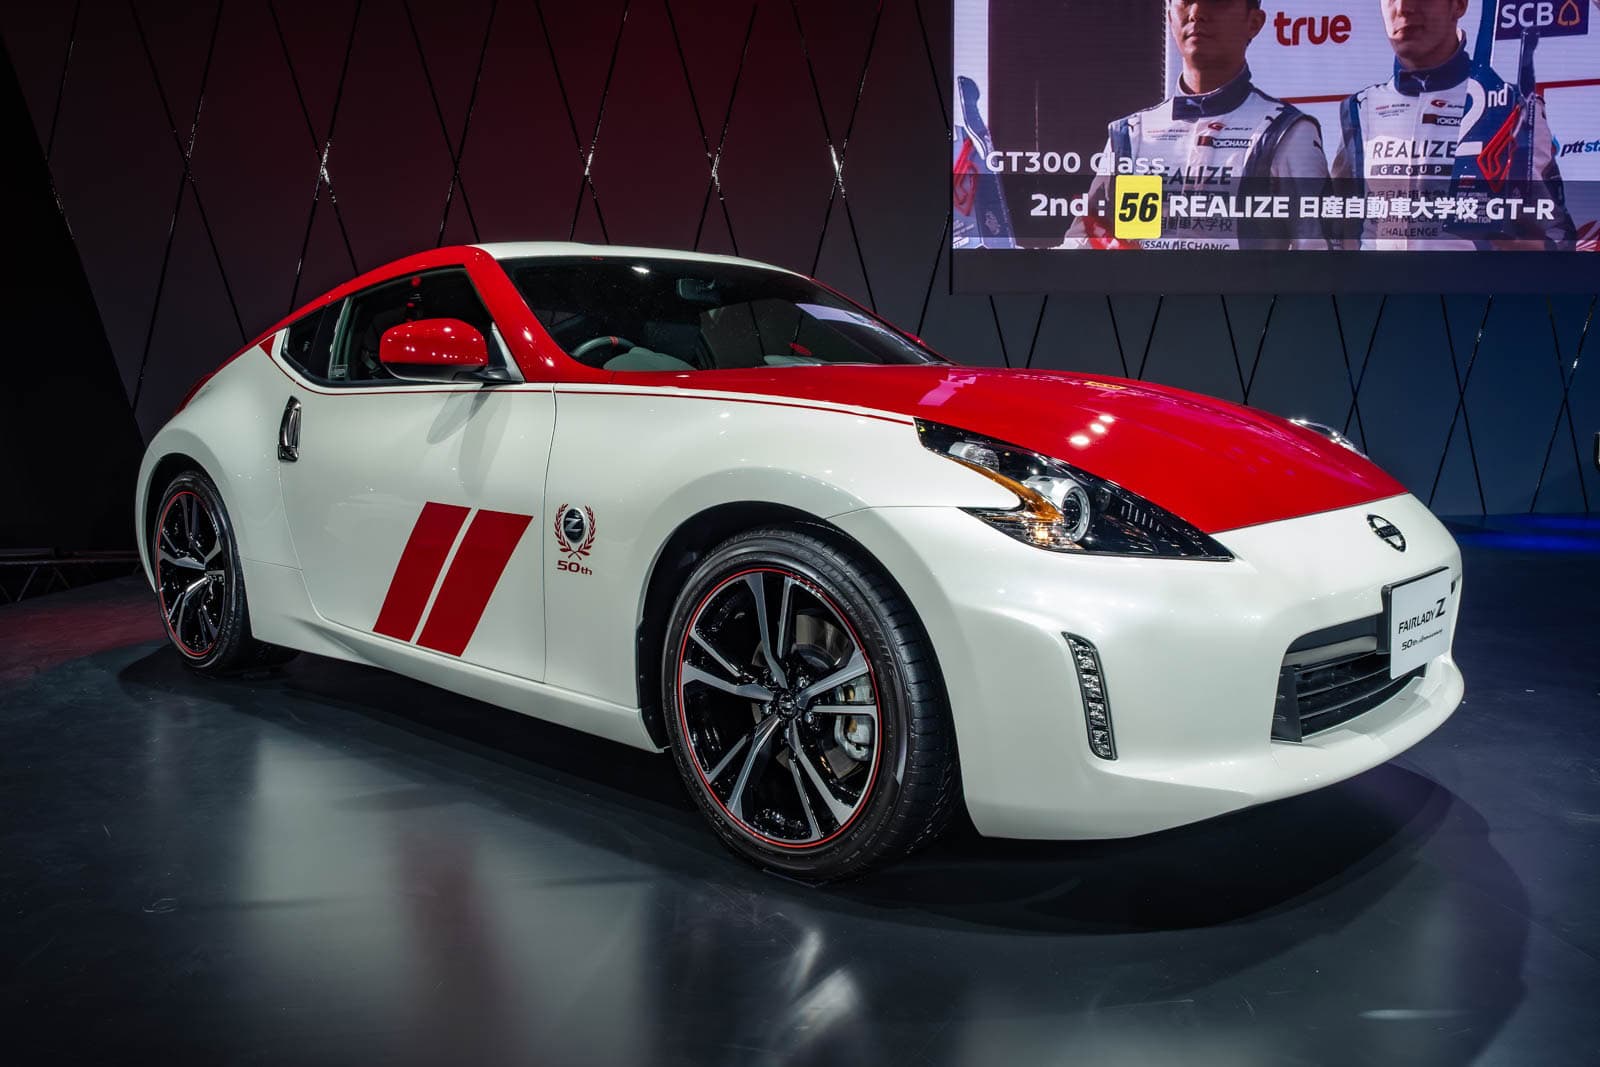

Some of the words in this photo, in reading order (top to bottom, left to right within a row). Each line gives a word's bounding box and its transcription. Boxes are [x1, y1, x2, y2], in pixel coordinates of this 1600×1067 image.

[1501, 3, 1554, 29] SCB
[1274, 12, 1352, 46] true
[1373, 140, 1457, 158] REALIZE
[986, 152, 1081, 173] GT300
[1090, 152, 1165, 174] Class
[1380, 165, 1442, 174] GROUP
[1157, 166, 1233, 185] EALIZE
[1030, 194, 1089, 217] 2nd
[1118, 193, 1159, 222] 56
[1169, 196, 1290, 218] REALIZE
[1299, 196, 1479, 220] 日産自動車大学校
[1486, 198, 1555, 220] GT-R
[557, 560, 592, 575] 50th
[1398, 608, 1436, 634] FAIRLADY
[1435, 597, 1446, 618] Z
